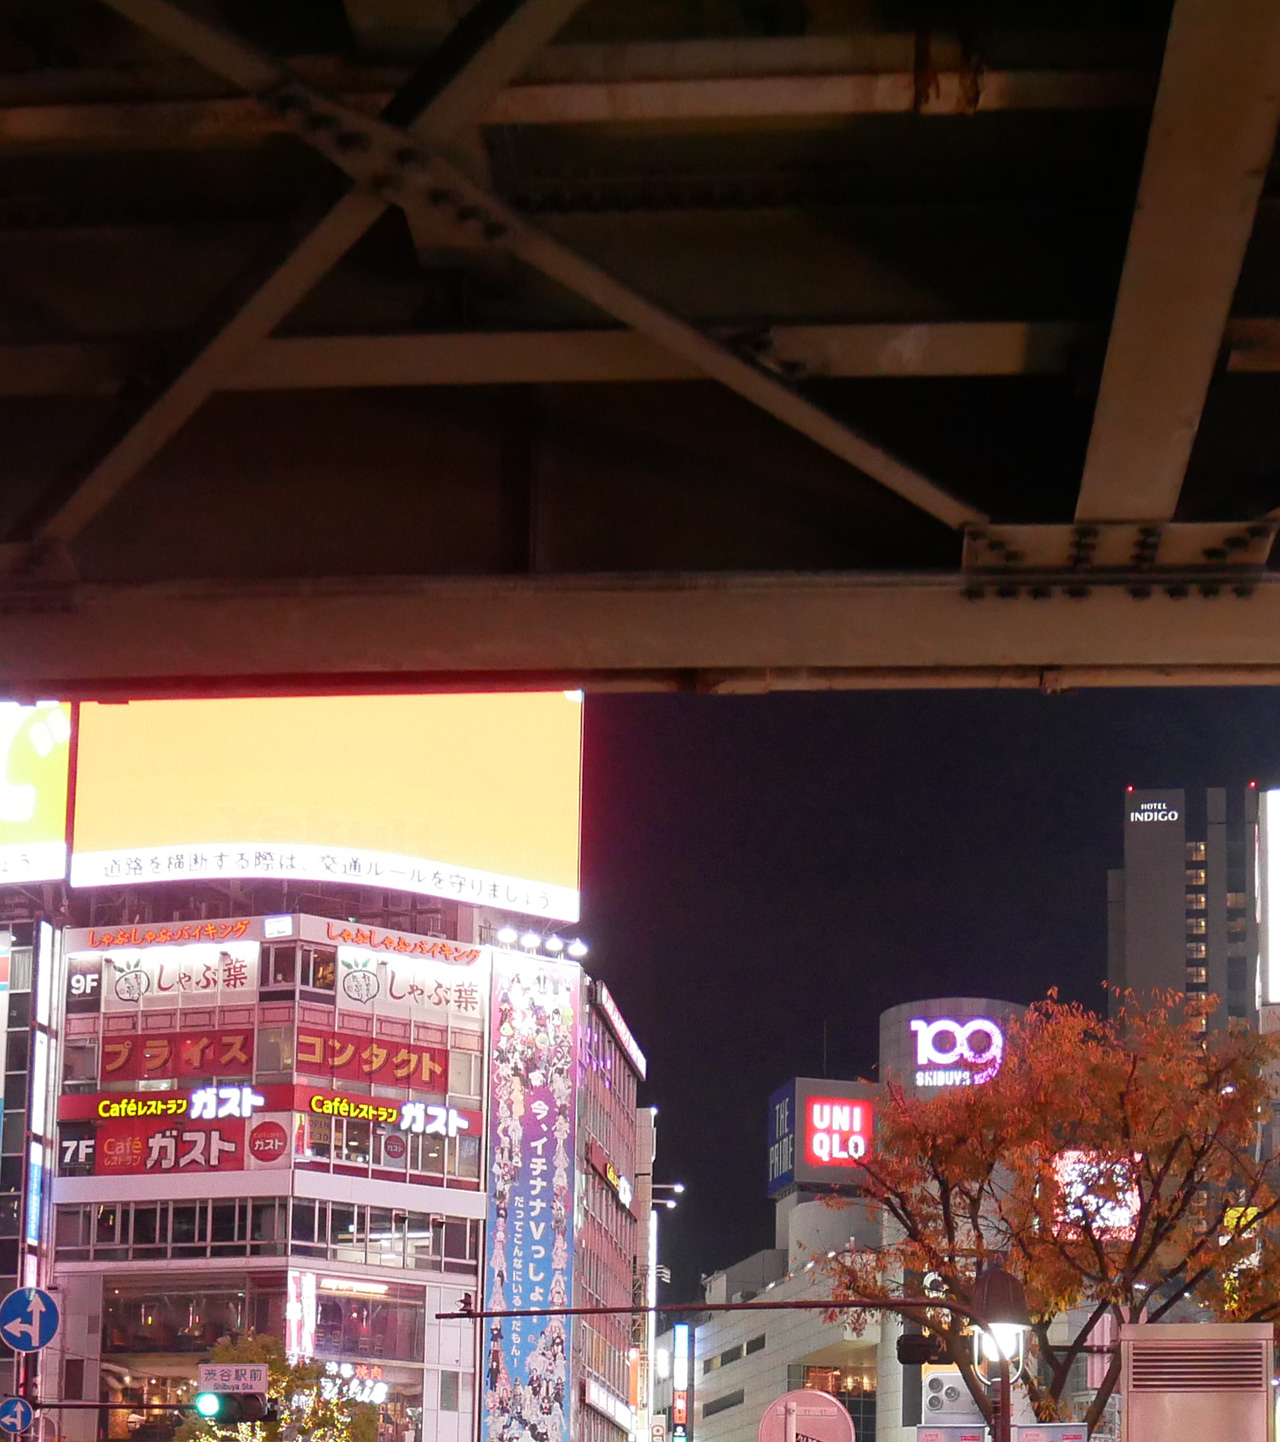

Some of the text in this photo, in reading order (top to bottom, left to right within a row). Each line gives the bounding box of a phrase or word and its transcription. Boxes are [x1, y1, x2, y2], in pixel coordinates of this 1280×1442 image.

[1130, 810, 1179, 823] INDIGO
[1140, 802, 1168, 811] HOTEL
[87, 918, 251, 948] しゃぶしゃぶバイキング
[326, 921, 482, 965] しゃぶしゃぶバイキング
[70, 973, 100, 996] 9F
[156, 957, 249, 992] しゃぶ葉
[388, 970, 479, 1012] しゃぶ葉
[102, 1034, 250, 1073] プライス
[297, 1034, 443, 1082] コンタクト
[910, 1018, 1004, 1086] 109
[189, 1086, 266, 1120] ガスト
[775, 1097, 790, 1140] THE
[812, 1104, 862, 1132] UNI
[399, 1101, 469, 1138] ガスト
[61, 1139, 96, 1163] 7F
[103, 1136, 142, 1156] Café
[145, 1129, 237, 1171] ガスト
[253, 1138, 284, 1151] ガスト
[769, 1133, 794, 1182] PRIME
[812, 1132, 866, 1162] QLO
[203, 1368, 263, 1382] 渋谷駅前
[213, 1382, 240, 1392] Shibuya
